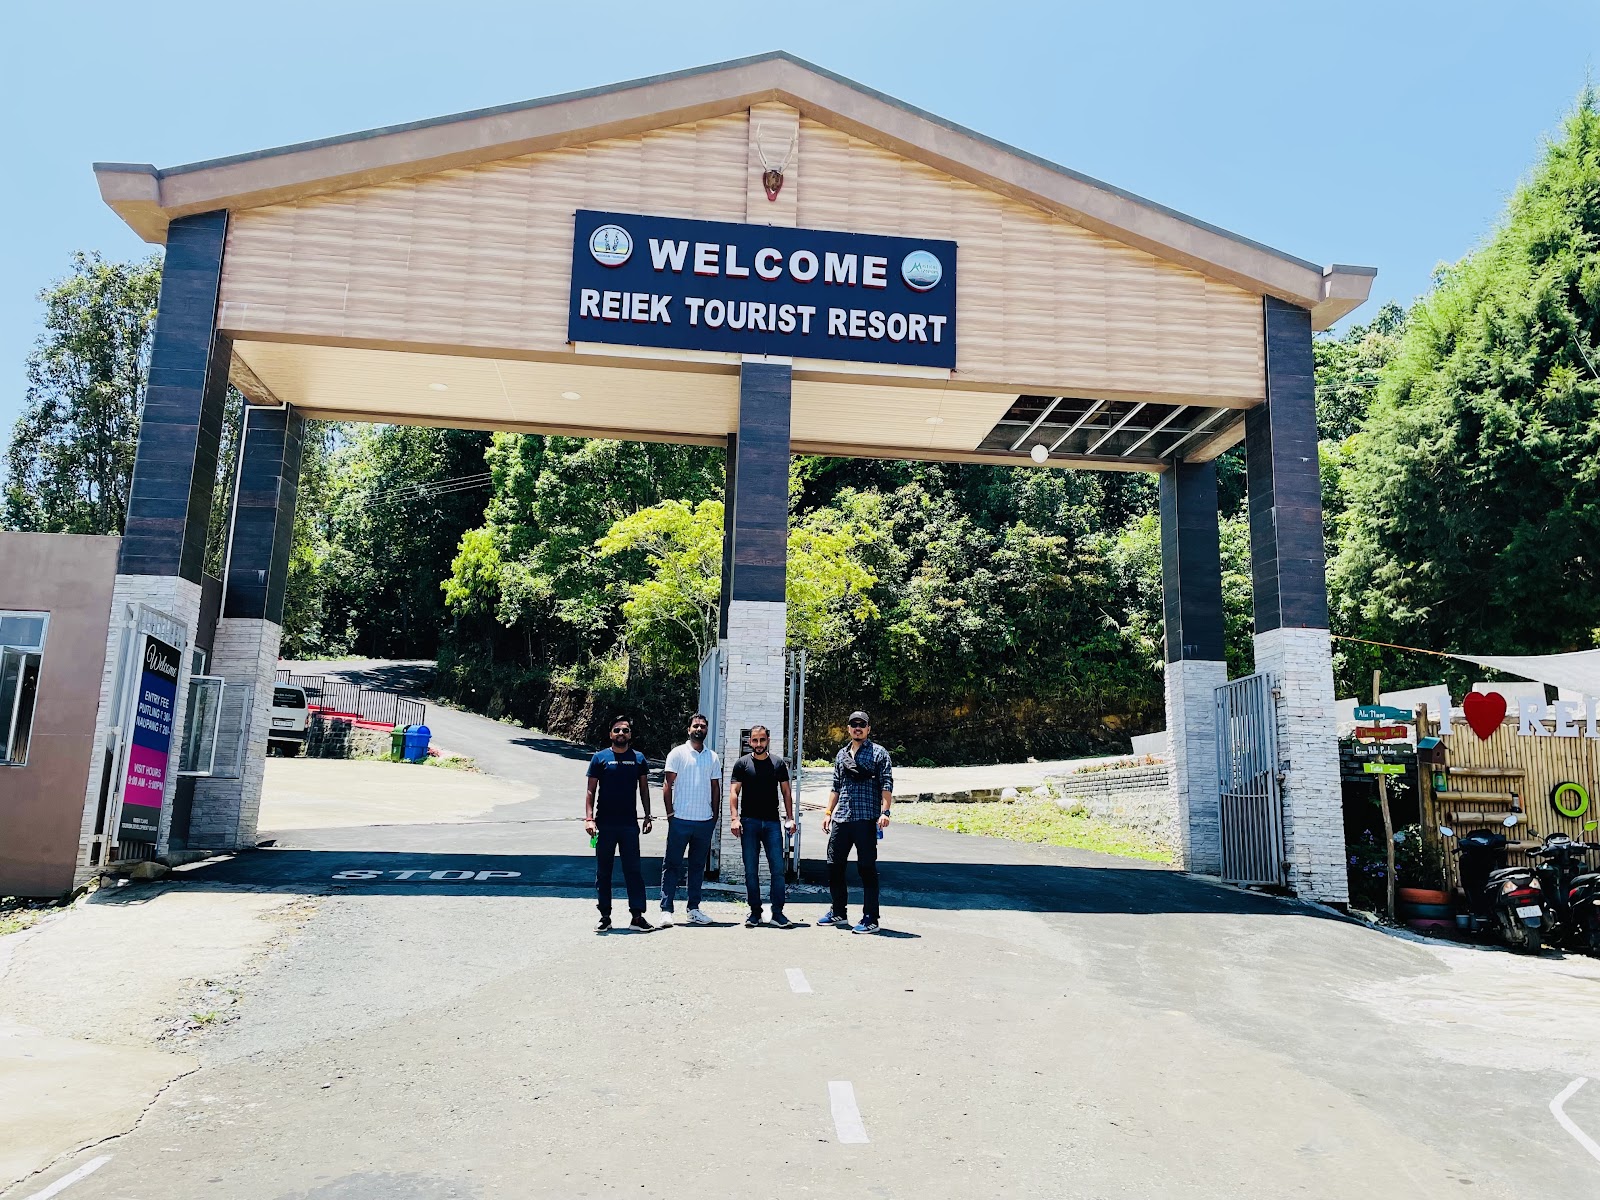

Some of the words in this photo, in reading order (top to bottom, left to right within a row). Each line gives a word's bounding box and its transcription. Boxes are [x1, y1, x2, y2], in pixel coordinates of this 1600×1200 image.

[648, 238, 888, 288] WELCOME
[579, 288, 672, 324] REIEK
[685, 296, 816, 336] TOURIST
[828, 307, 947, 344] RESORT
[146, 643, 177, 677] Welcome
[144, 690, 160, 705] ENTRY
[160, 697, 170, 709] FEE
[1438, 695, 1454, 735] I
[134, 763, 146, 774] VISIT
[145, 766, 161, 778] HOURS
[137, 777, 145, 787] AM
[331, 869, 522, 881] STOP
